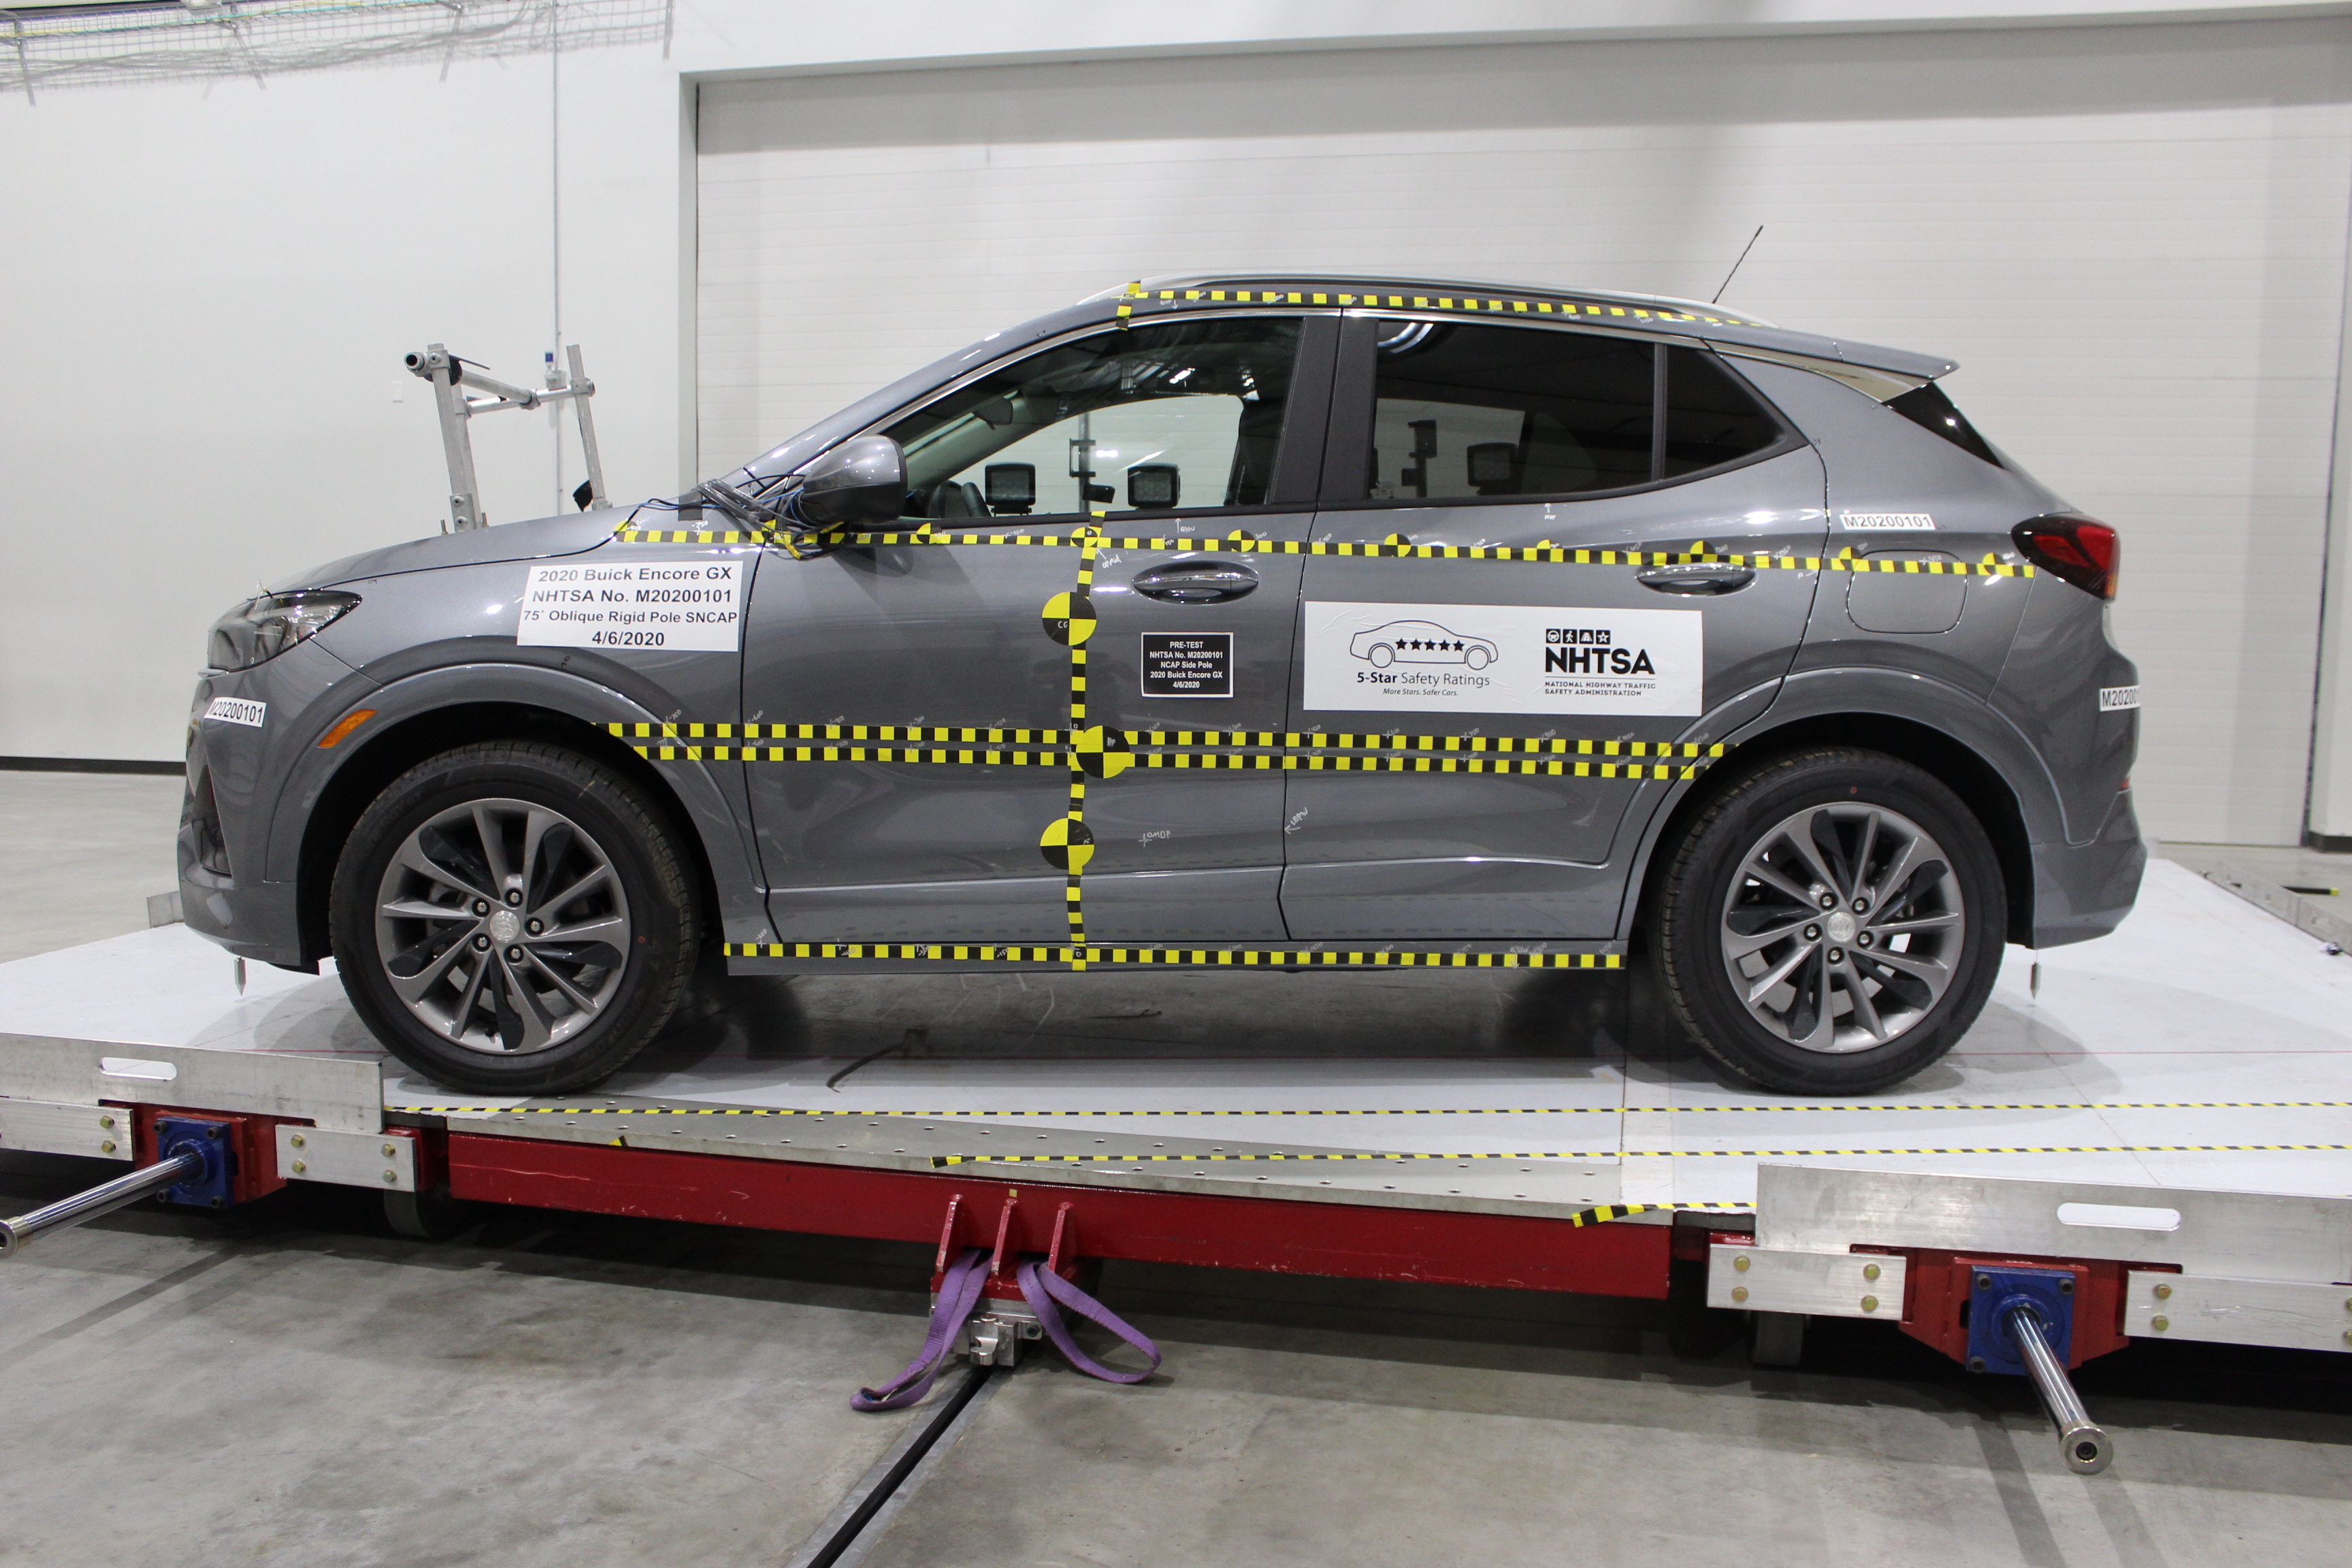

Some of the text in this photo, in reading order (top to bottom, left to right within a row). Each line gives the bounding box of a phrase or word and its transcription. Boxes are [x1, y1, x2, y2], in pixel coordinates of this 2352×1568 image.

[1843, 516, 1933, 527] M20200101
[538, 567, 732, 582] 2020 Buick Encore GX
[532, 589, 732, 603] NHTSA No. M20200101
[549, 610, 604, 623] Oblique
[608, 611, 645, 625] Rigid
[650, 611, 681, 623] Pole
[685, 612, 738, 623] SNCAP
[592, 631, 665, 646] 4/6/2020
[1545, 647, 1656, 674] NHTSA
[1173, 681, 1200, 689] 4/6/2020
[1356, 671, 1490, 689] 5-Star Safety Ratings
[1422, 688, 1441, 696] Safer
